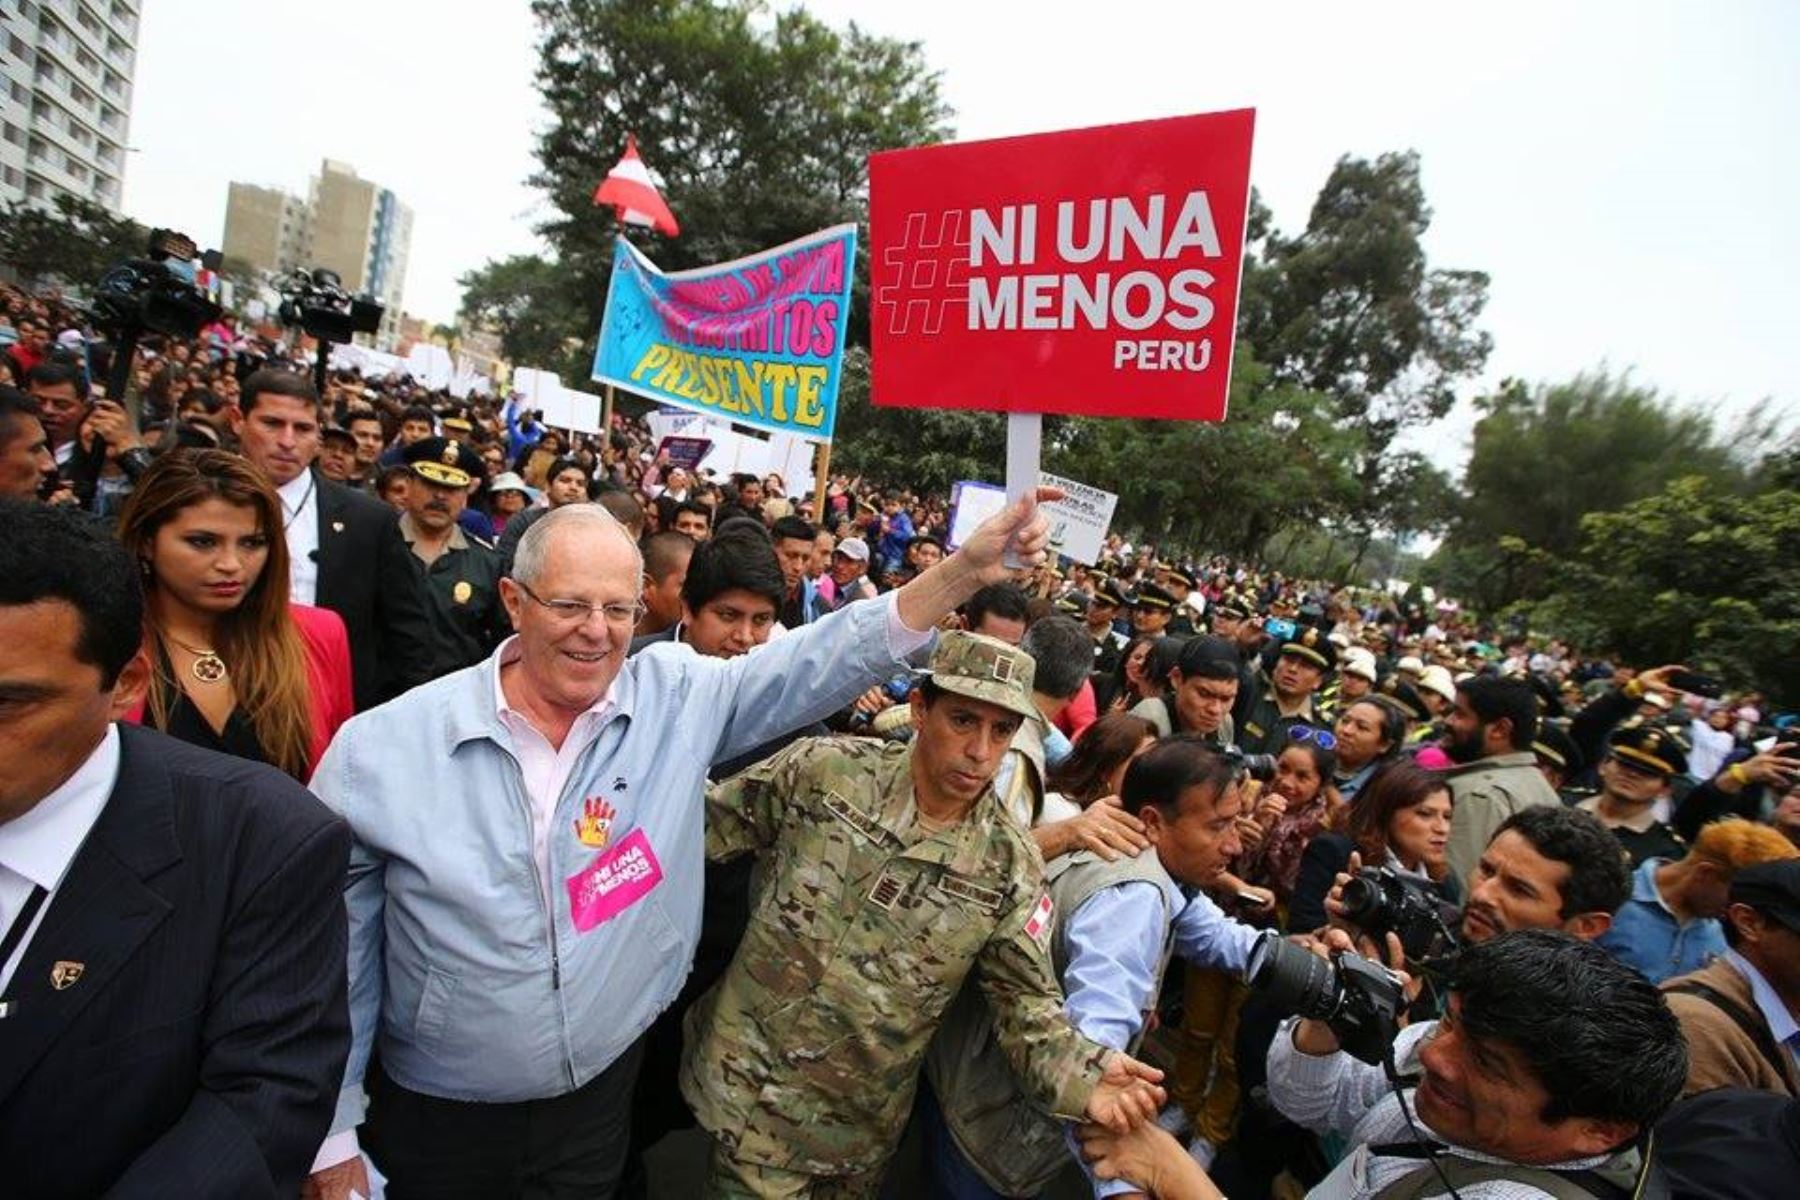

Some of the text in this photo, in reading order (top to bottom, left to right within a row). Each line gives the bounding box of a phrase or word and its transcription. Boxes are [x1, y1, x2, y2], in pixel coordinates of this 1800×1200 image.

[1056, 190, 1222, 263] UNA
[967, 269, 1216, 331] MENOS
[1114, 338, 1212, 371] PERÚ
[630, 343, 827, 428] PRESENTE
[597, 857, 649, 896] MENOS
[613, 846, 644, 872] UNA
